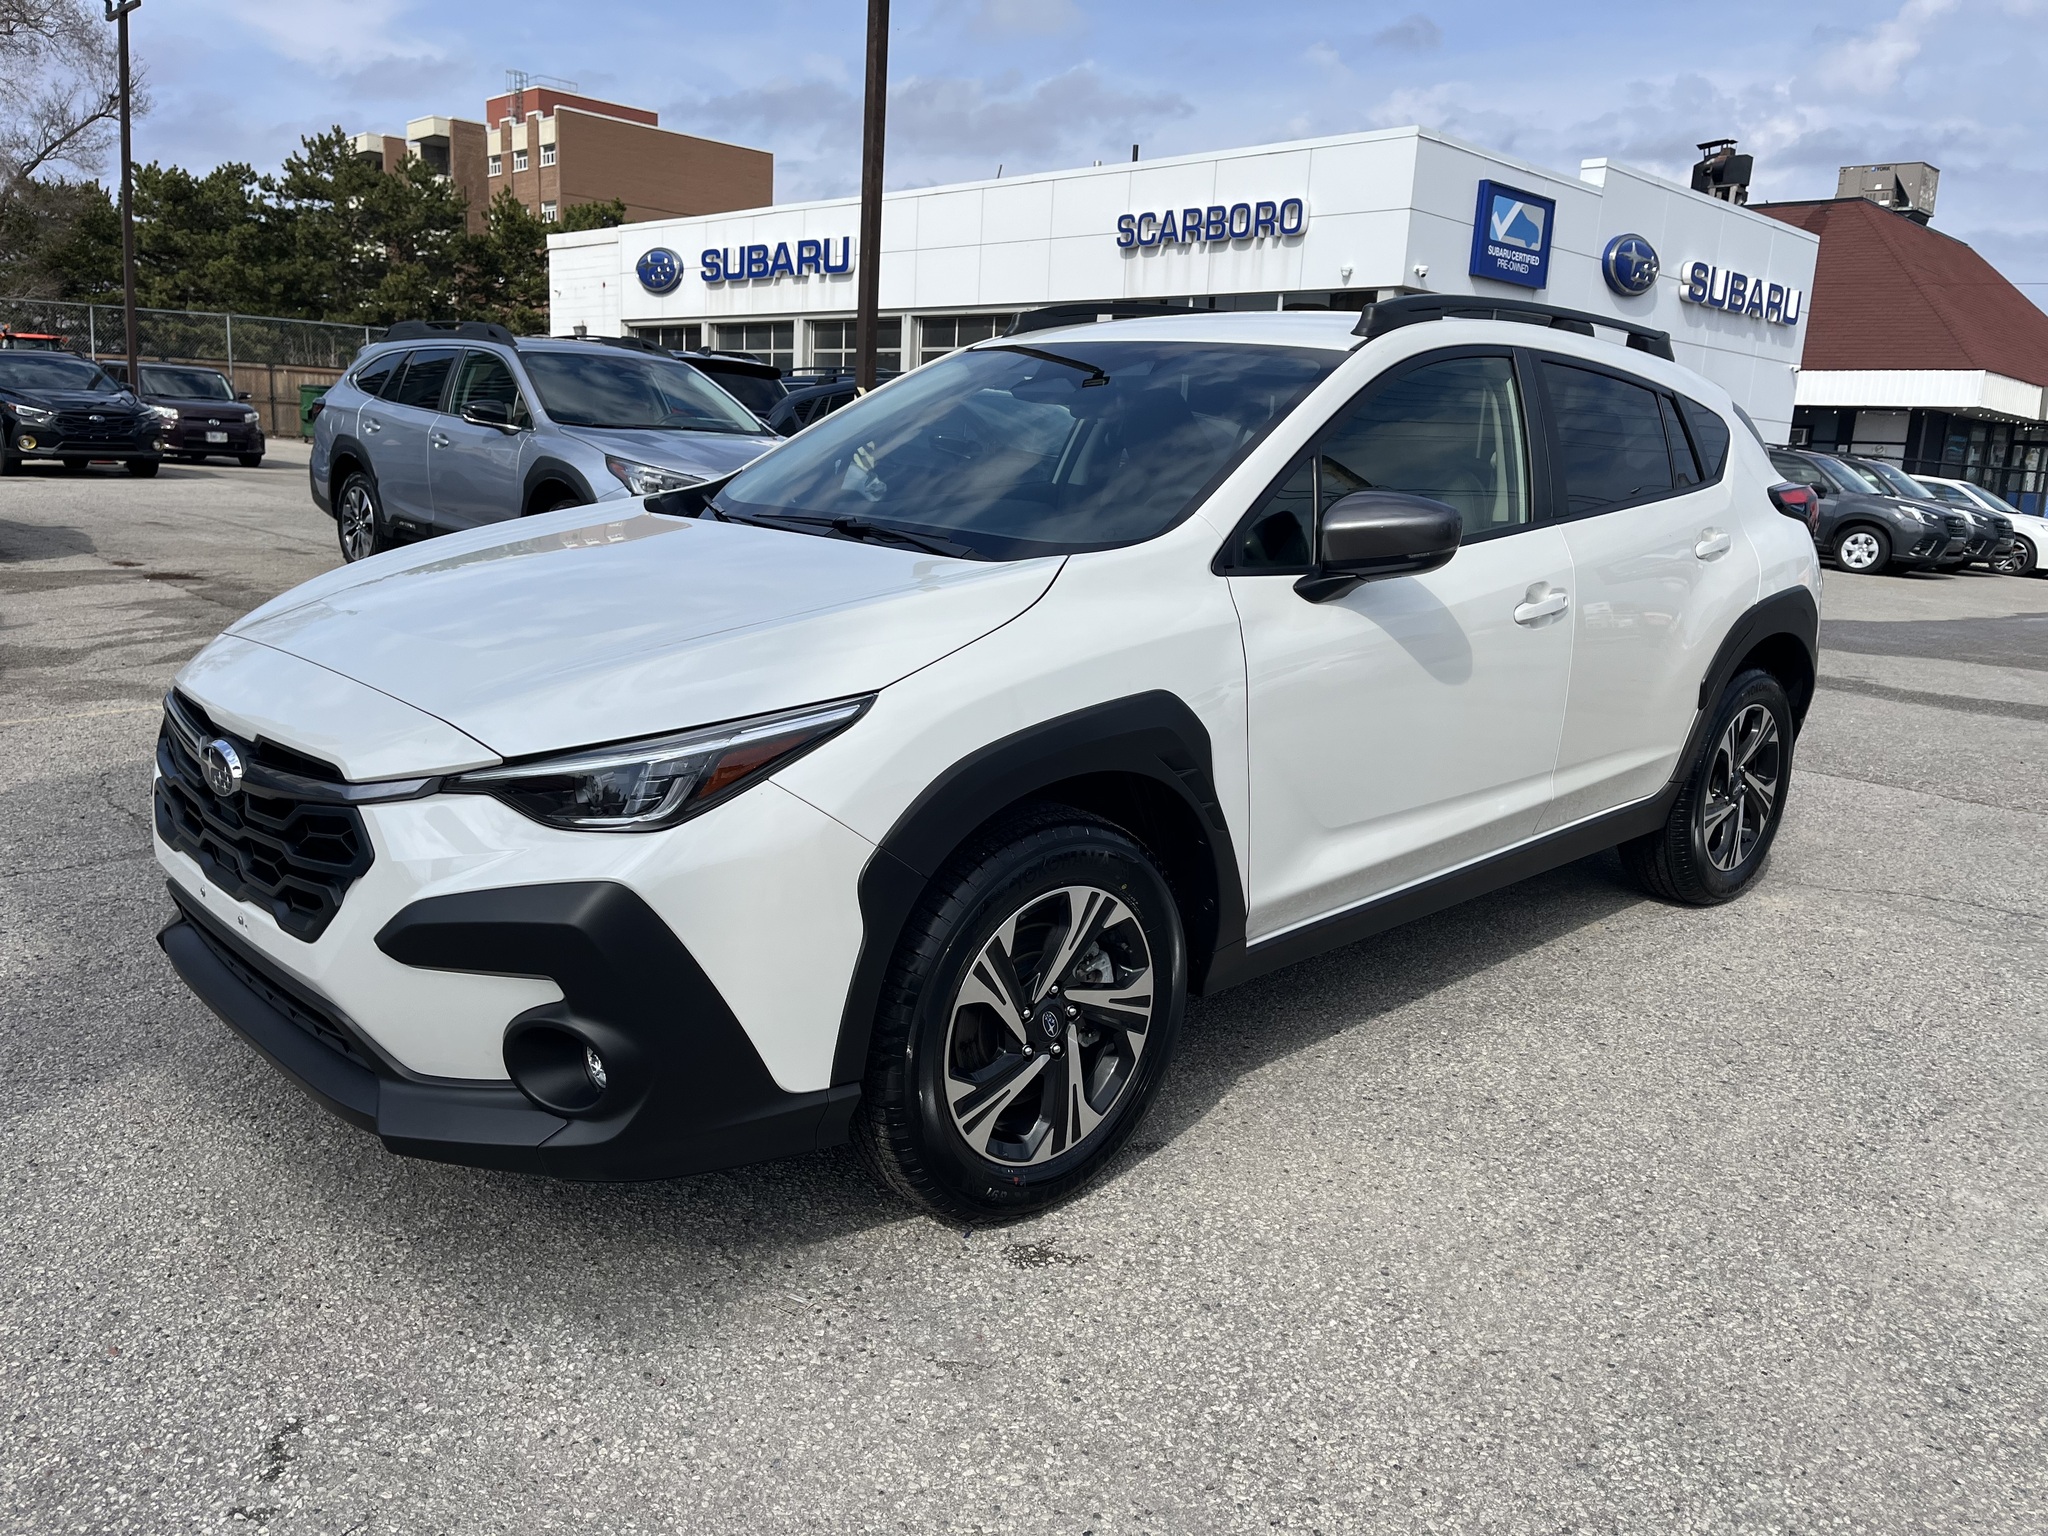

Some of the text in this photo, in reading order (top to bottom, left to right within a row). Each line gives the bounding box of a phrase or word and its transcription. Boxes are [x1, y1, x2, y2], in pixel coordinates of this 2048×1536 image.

[1116, 197, 1304, 248] SCARBORO
[700, 236, 850, 282] SUBARU
[1488, 244, 1539, 265] SUBARU CERTIFIED
[1497, 258, 1529, 273] PRE-OWNED
[1687, 261, 1803, 326] SUBARU
